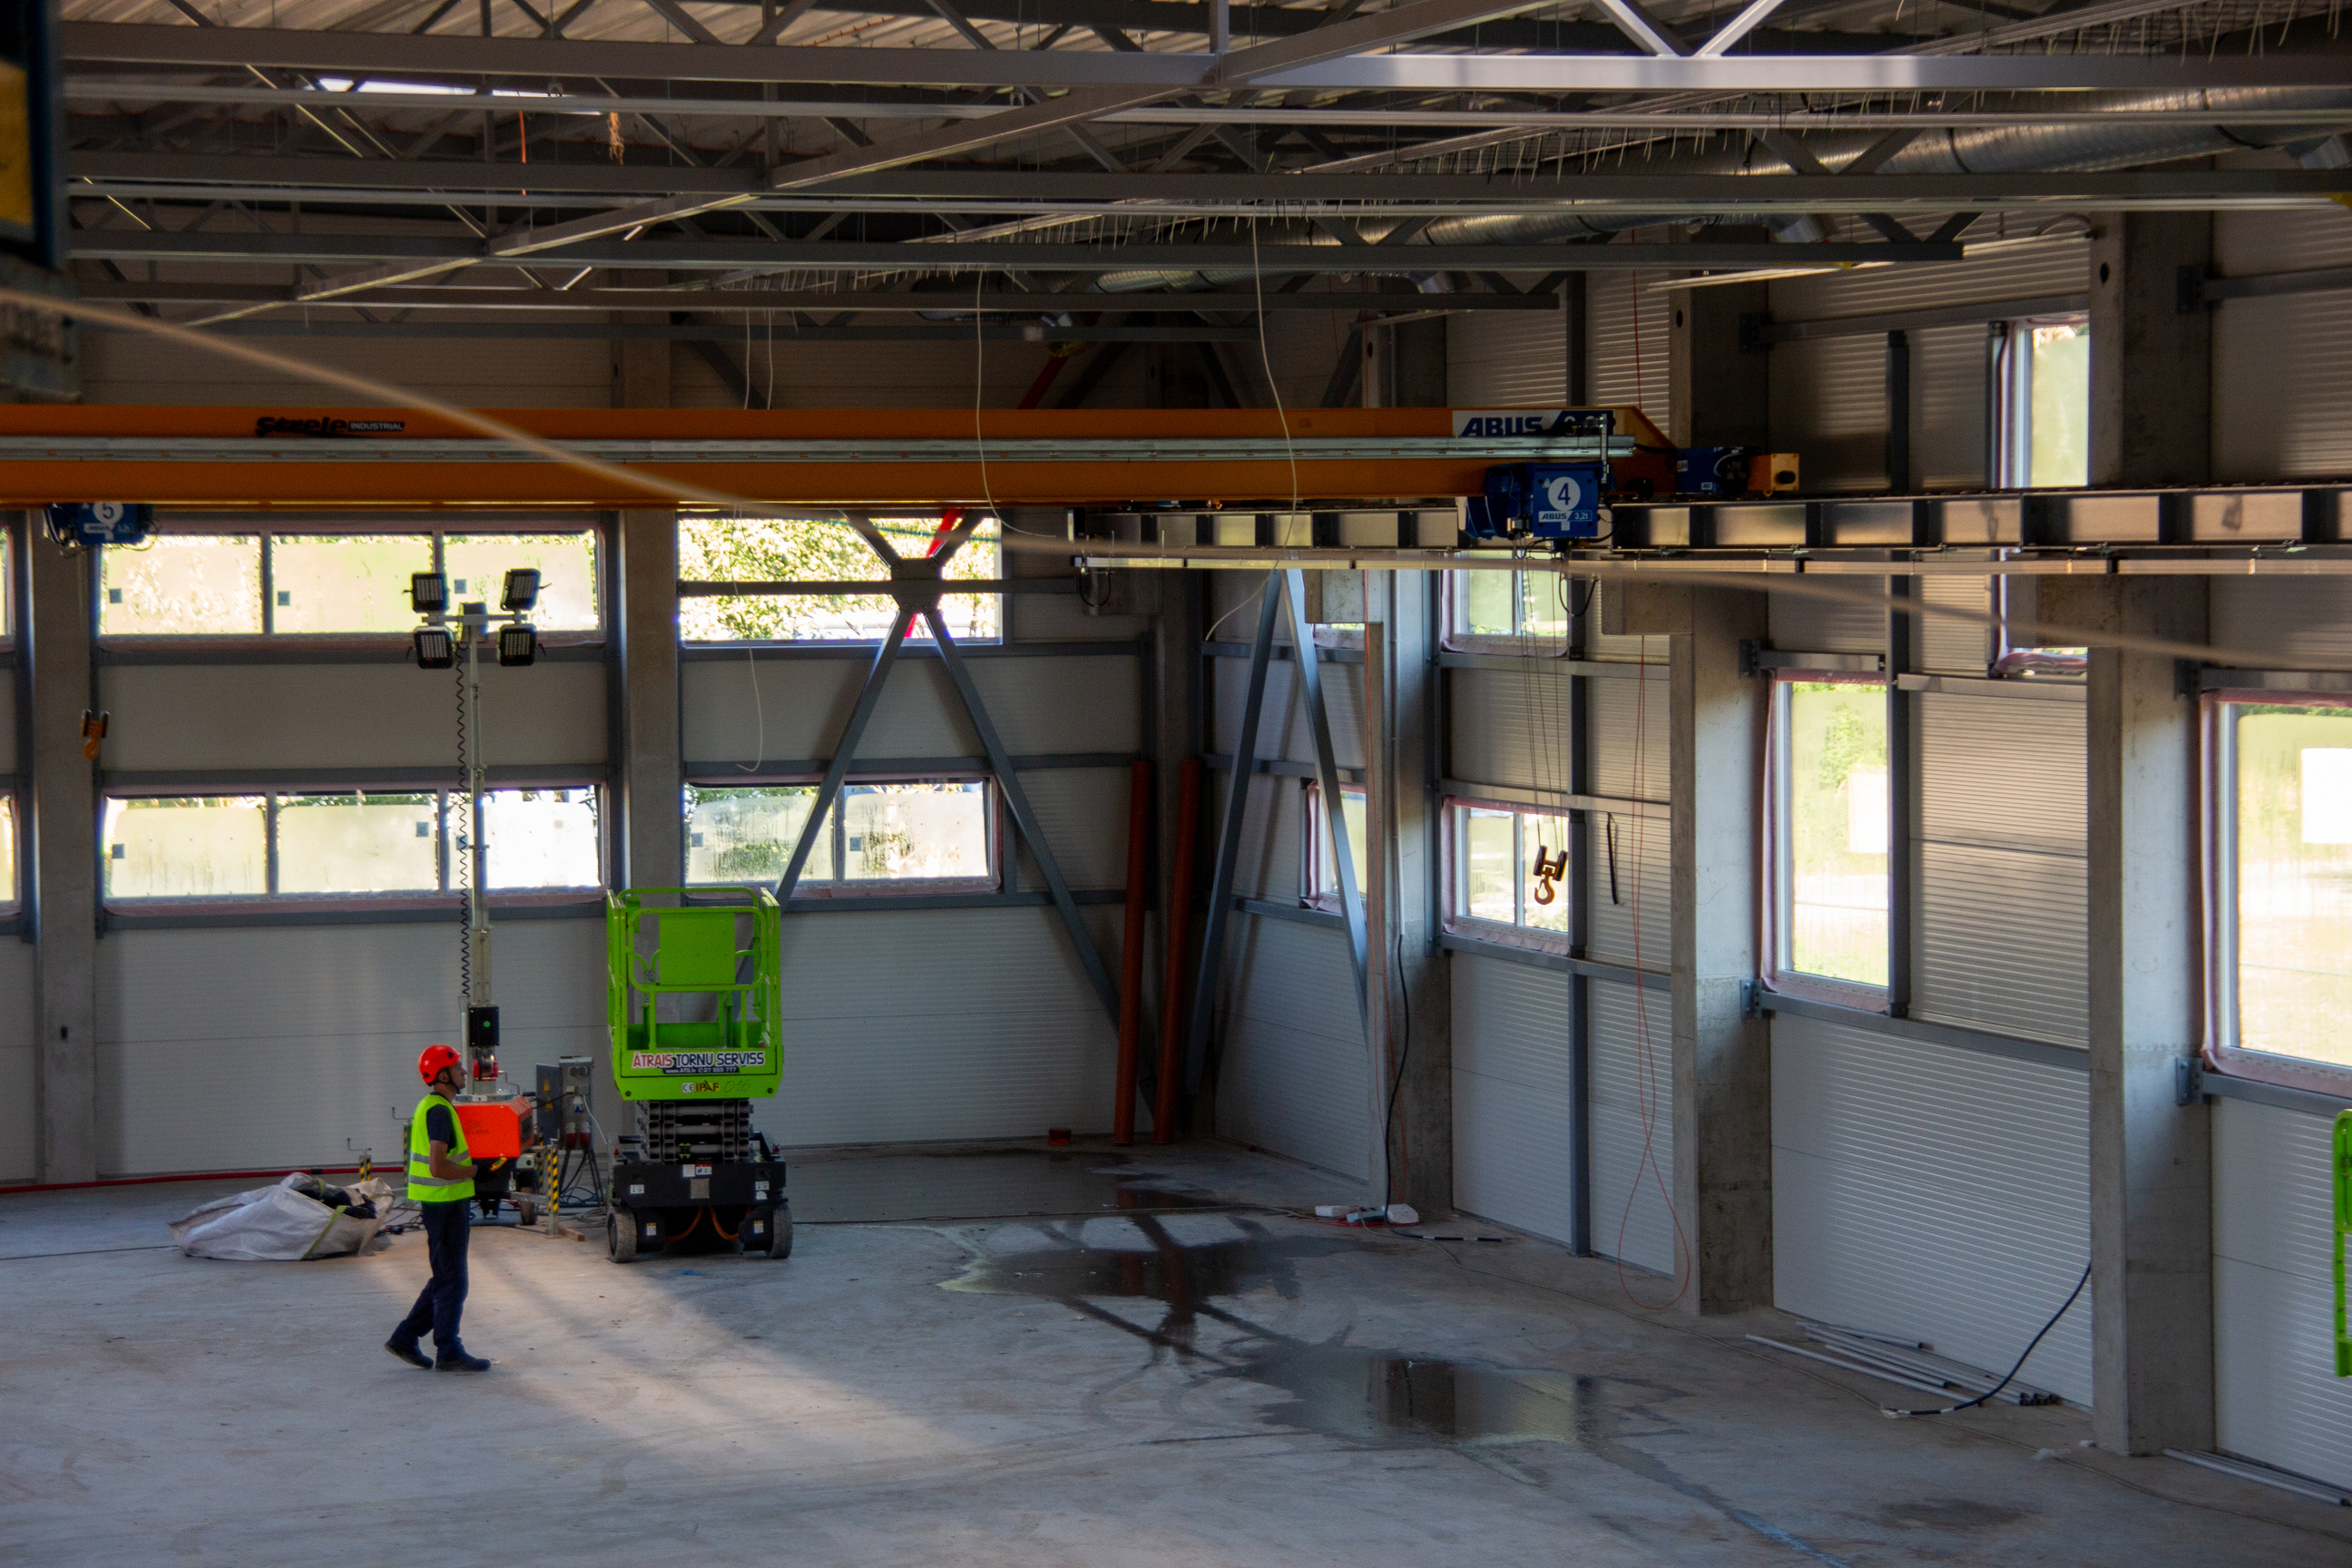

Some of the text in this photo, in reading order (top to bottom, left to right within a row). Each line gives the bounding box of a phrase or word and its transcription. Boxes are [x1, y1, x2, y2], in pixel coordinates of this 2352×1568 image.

[350, 422, 404, 431] INDUSTRIAL
[1461, 416, 1544, 436] ABUS
[1557, 482, 1572, 505] 4
[103, 502, 114, 520] 5
[1574, 512, 1589, 521] 3,2t
[632, 1052, 765, 1067] ĀTRAIS TORNU SERVISS
[696, 1080, 720, 1092] IPAF
